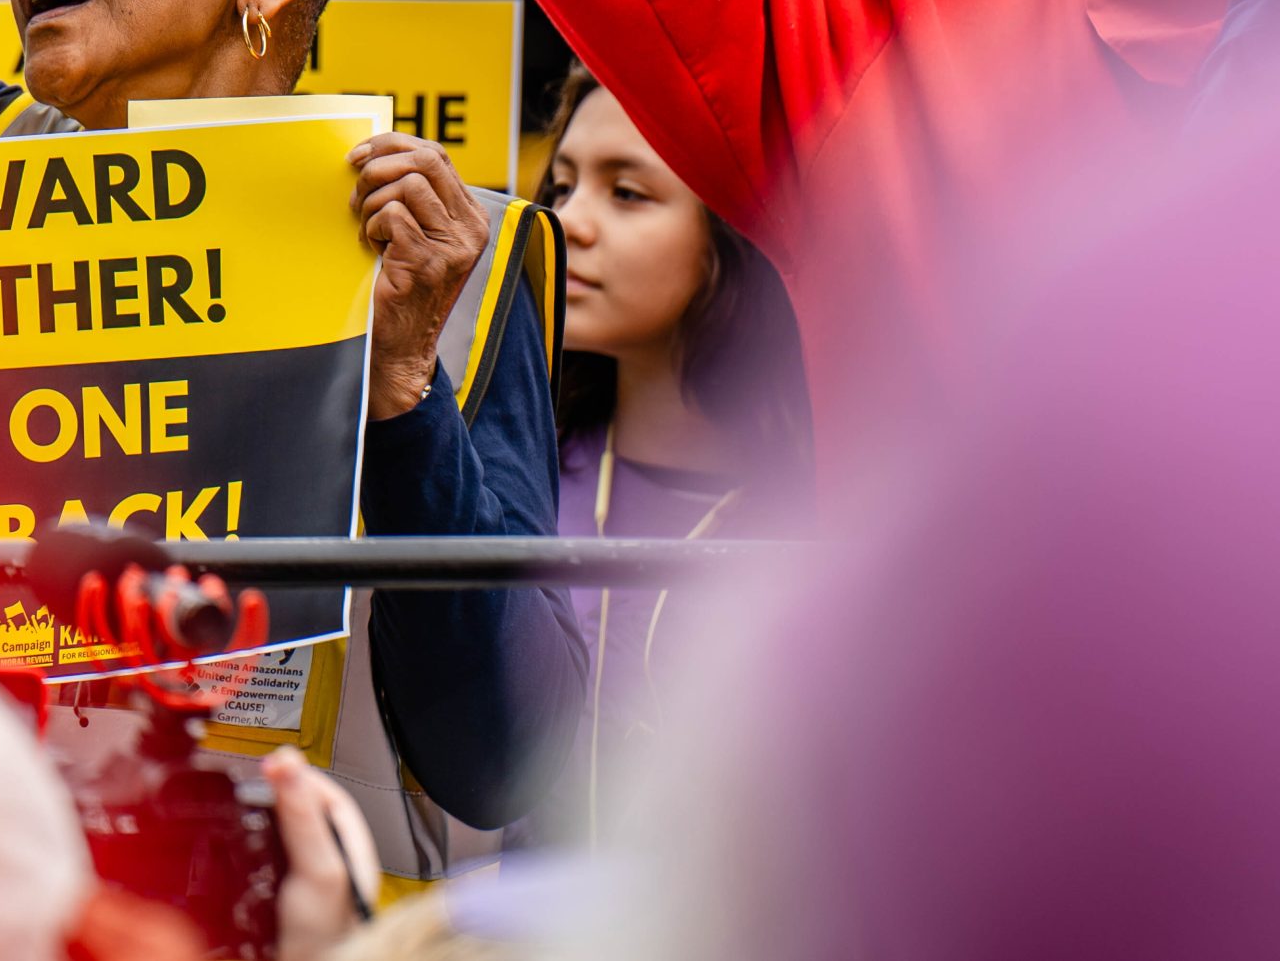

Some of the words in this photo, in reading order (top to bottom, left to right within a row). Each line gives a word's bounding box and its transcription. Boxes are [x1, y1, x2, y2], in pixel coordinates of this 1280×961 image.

[360, 92, 466, 144] HE
[8, 380, 191, 463] ONE
[2, 640, 51, 654] Campaign
[26, 655, 54, 665] REVIVAL
[62, 652, 76, 660] FOR
[242, 663, 304, 677] Amazonians
[197, 669, 232, 683] United
[234, 675, 249, 685] for
[250, 677, 300, 690] Solidarity
[220, 686, 294, 702] Empowerment
[224, 700, 266, 713] (CAUSE)
[217, 712, 251, 726] Garner,
[254, 716, 269, 726] NC
